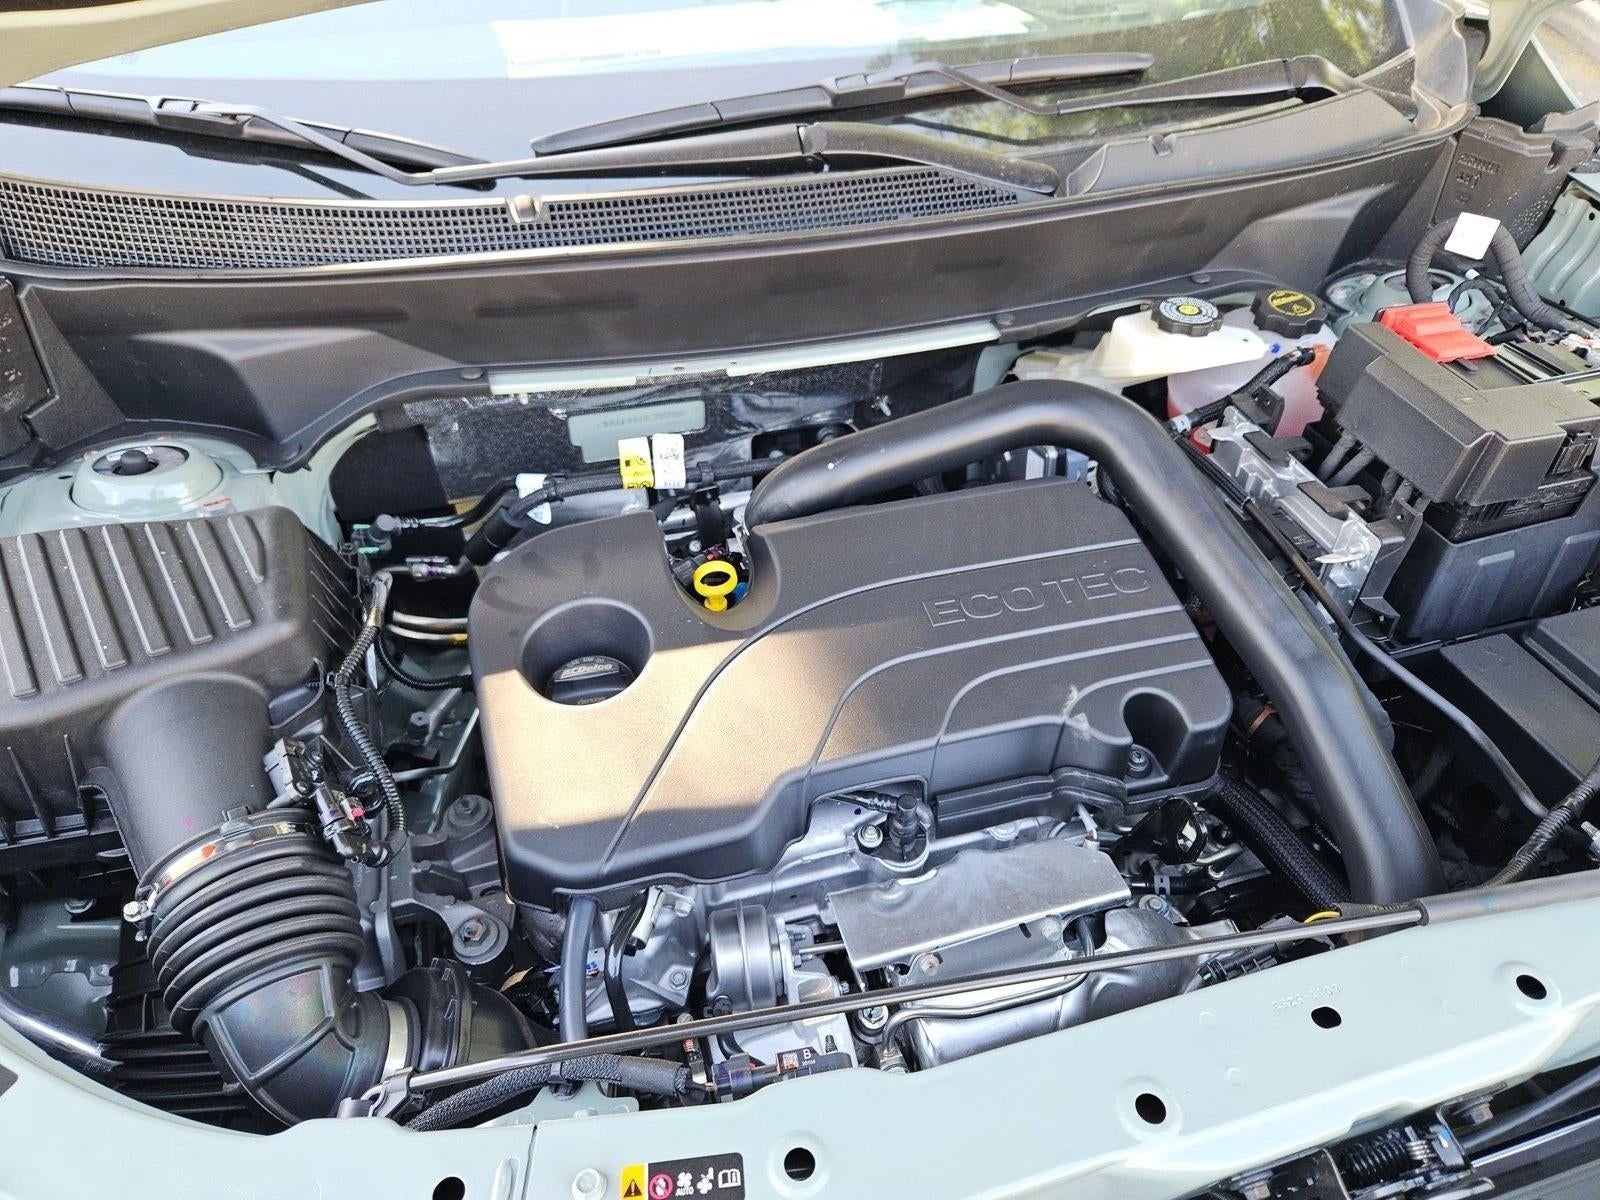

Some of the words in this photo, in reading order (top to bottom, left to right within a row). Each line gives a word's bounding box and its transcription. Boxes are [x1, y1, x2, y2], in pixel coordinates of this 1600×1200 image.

[922, 567, 1151, 628] ECOTEC
[560, 664, 613, 679] ACDelco
[802, 1048, 812, 1060] B
[675, 1186, 695, 1197] AUTO
